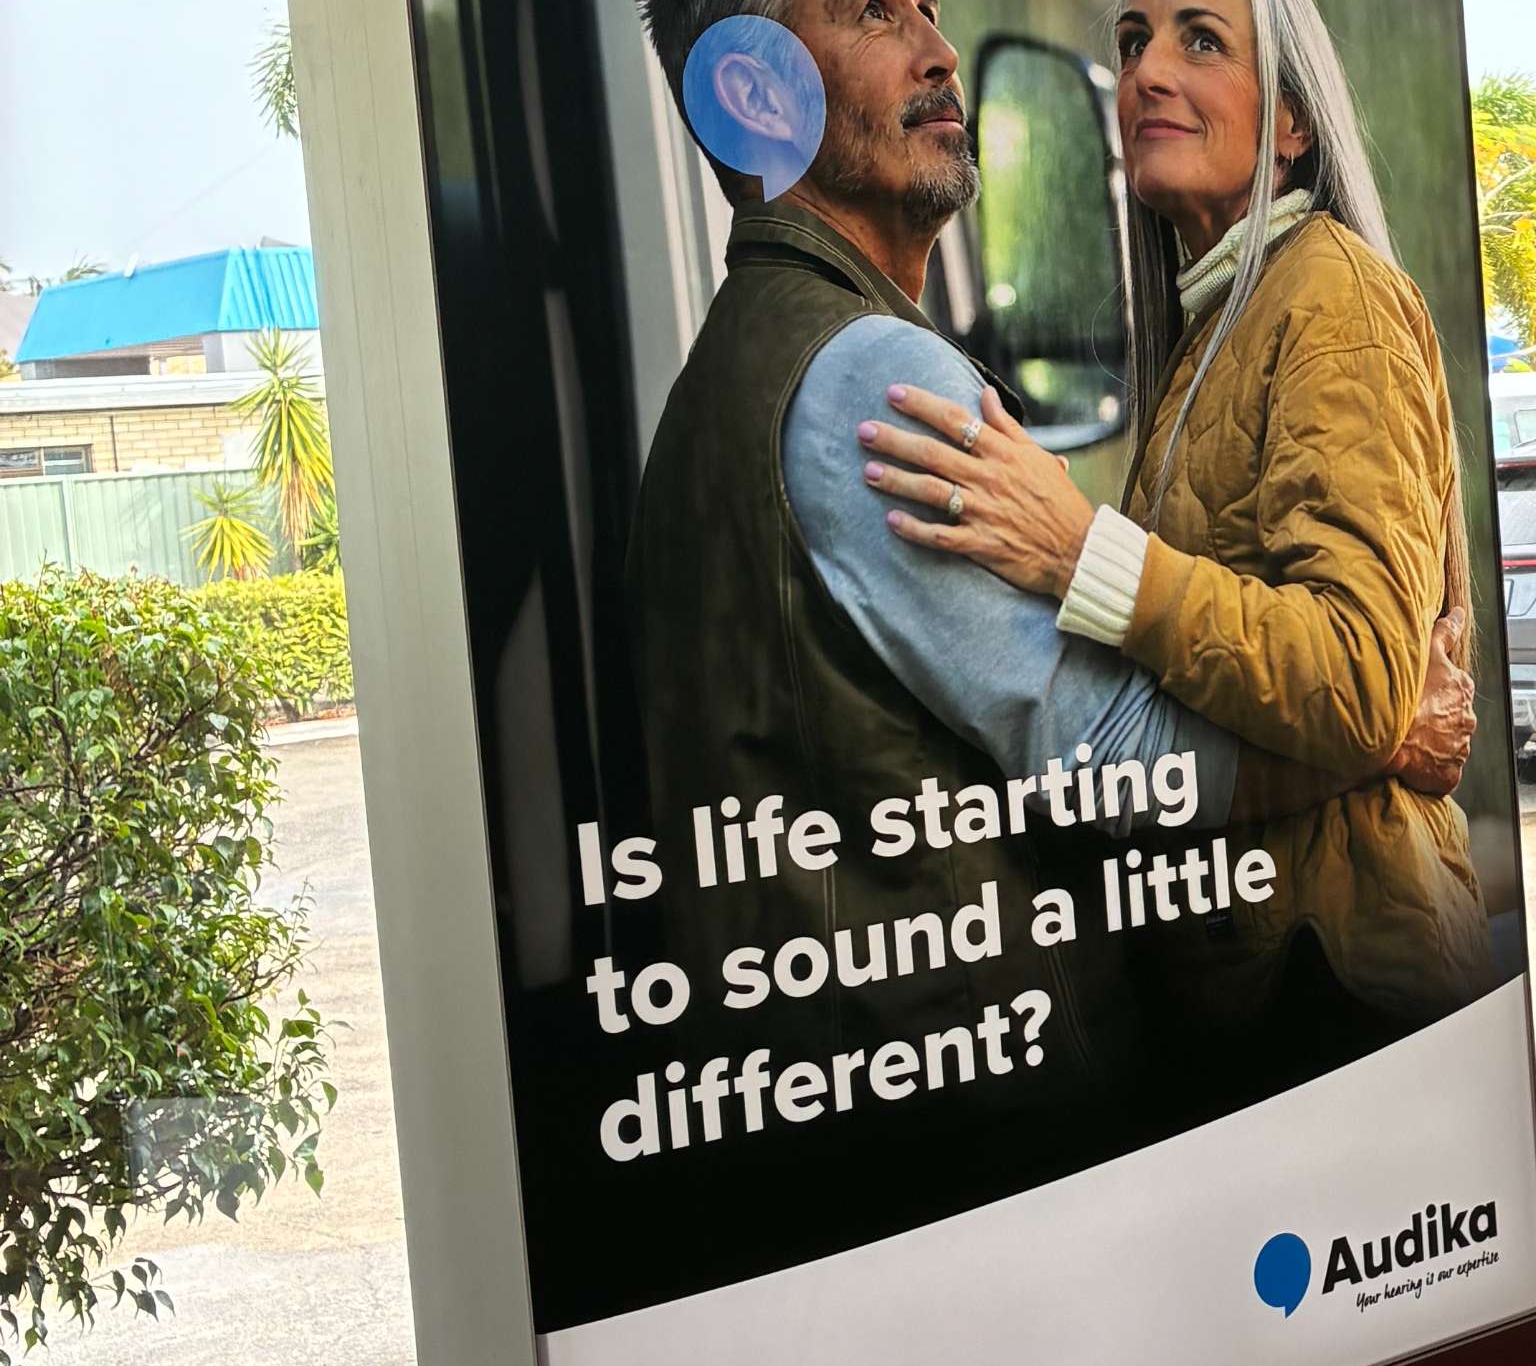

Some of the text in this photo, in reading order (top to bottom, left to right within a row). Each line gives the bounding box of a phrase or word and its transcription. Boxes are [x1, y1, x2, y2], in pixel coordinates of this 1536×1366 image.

[578, 742, 1198, 906] Is life starting
[586, 837, 1277, 1034] to sound a little
[600, 989, 1051, 1162] different?
[1321, 1200, 1498, 1295] Audika
[1356, 1250, 1500, 1313] Your hearing is our expertise
